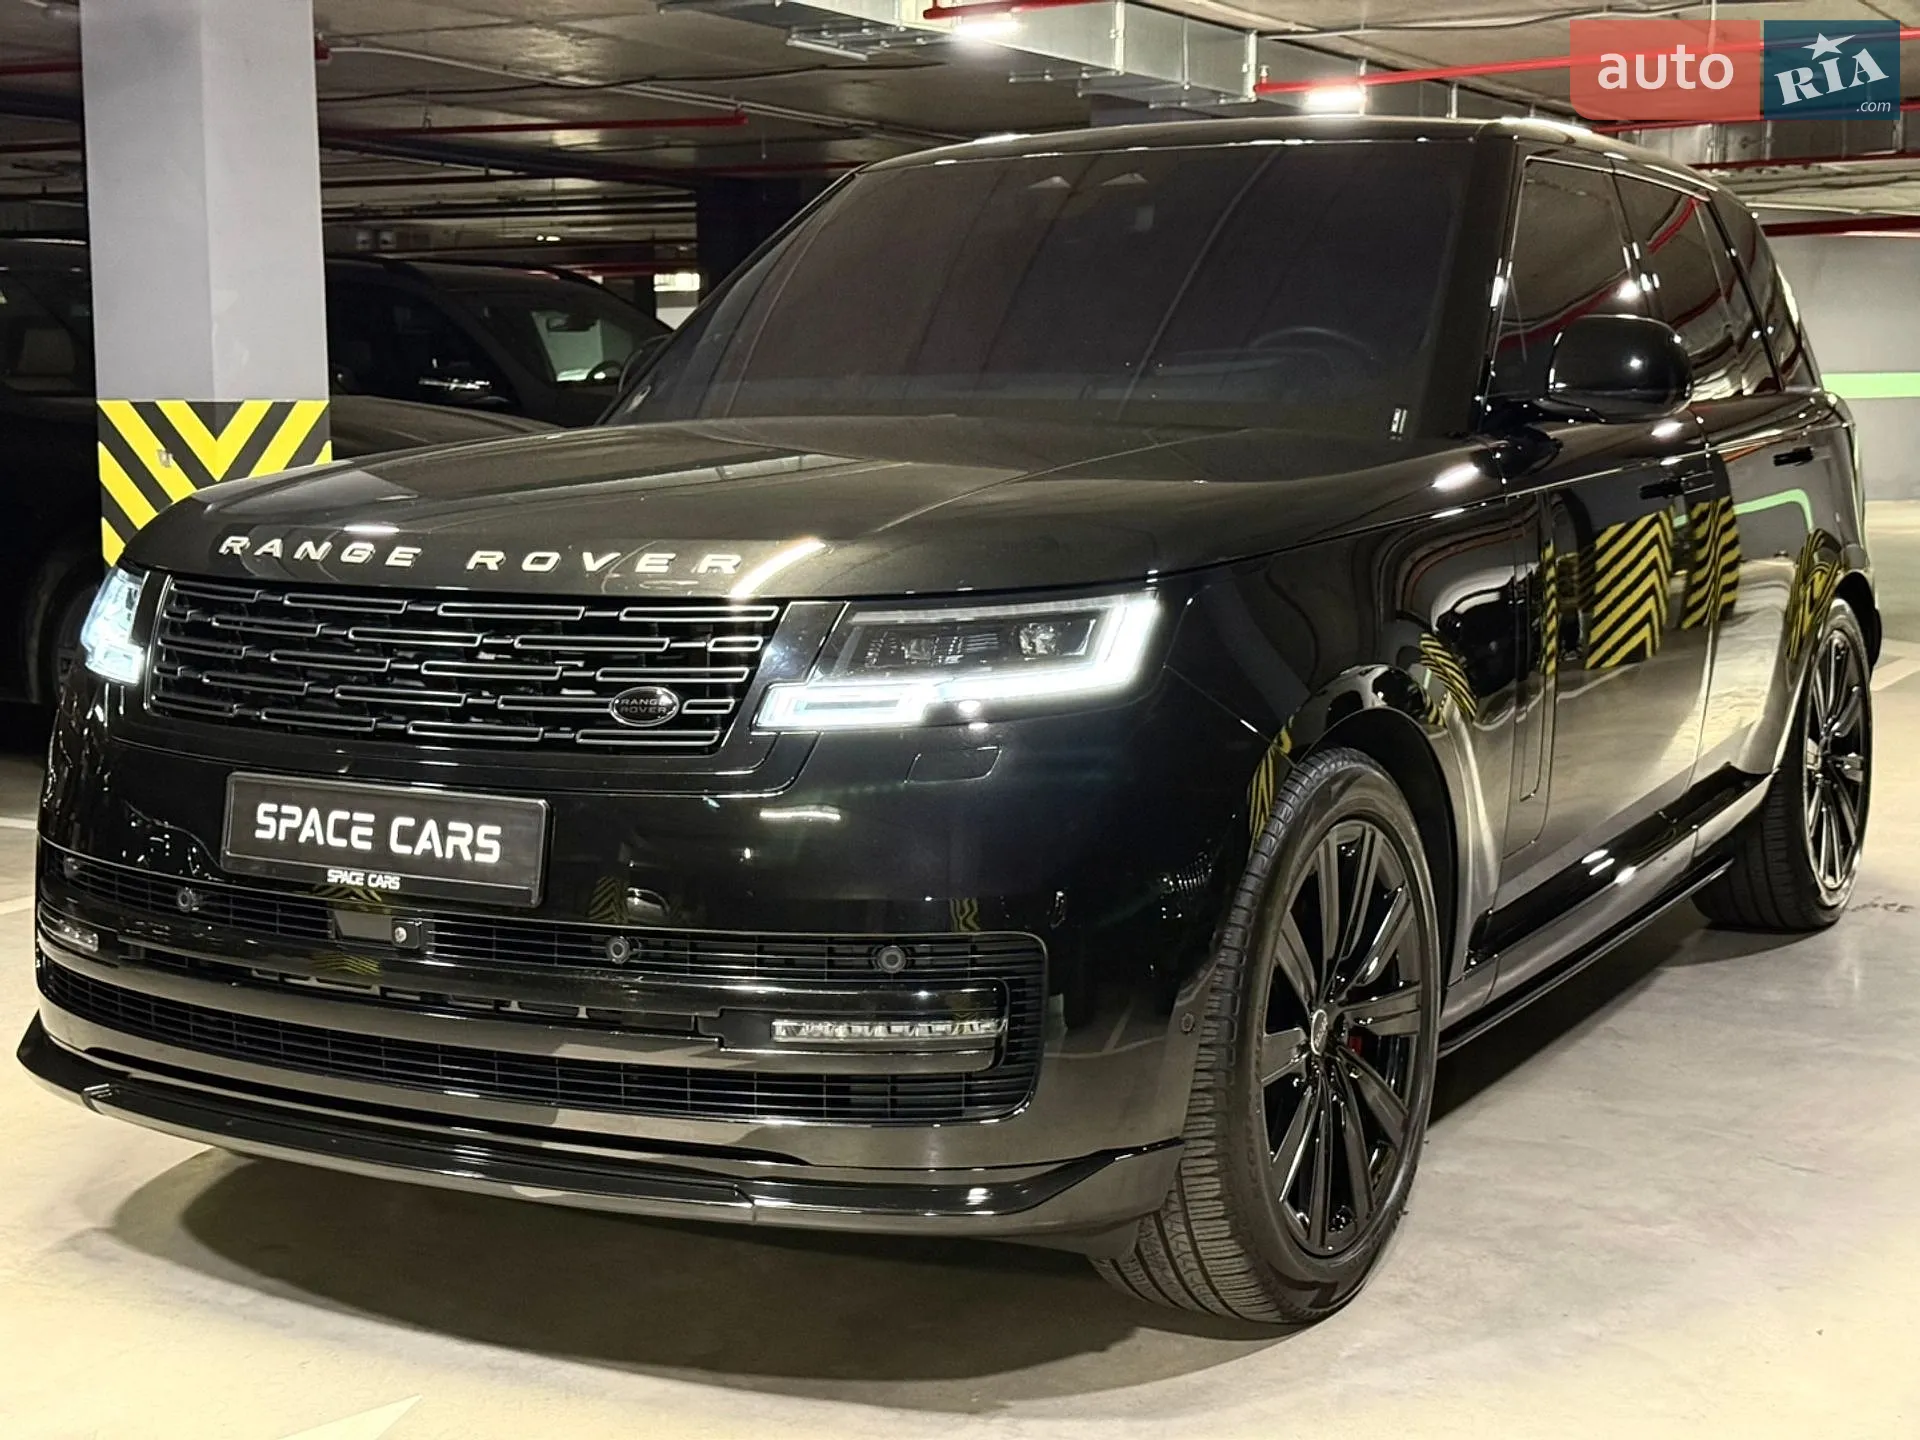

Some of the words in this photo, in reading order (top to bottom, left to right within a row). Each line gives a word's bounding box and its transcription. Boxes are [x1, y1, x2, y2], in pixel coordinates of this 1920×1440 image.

[218, 536, 422, 568] RANGE
[465, 550, 742, 574] ROVER
[620, 698, 673, 706] RANG
[620, 706, 667, 714] ROVER
[255, 802, 375, 850] SPACE
[389, 816, 501, 864] CARS
[327, 869, 365, 886] SPACE
[367, 873, 400, 890] CARS
